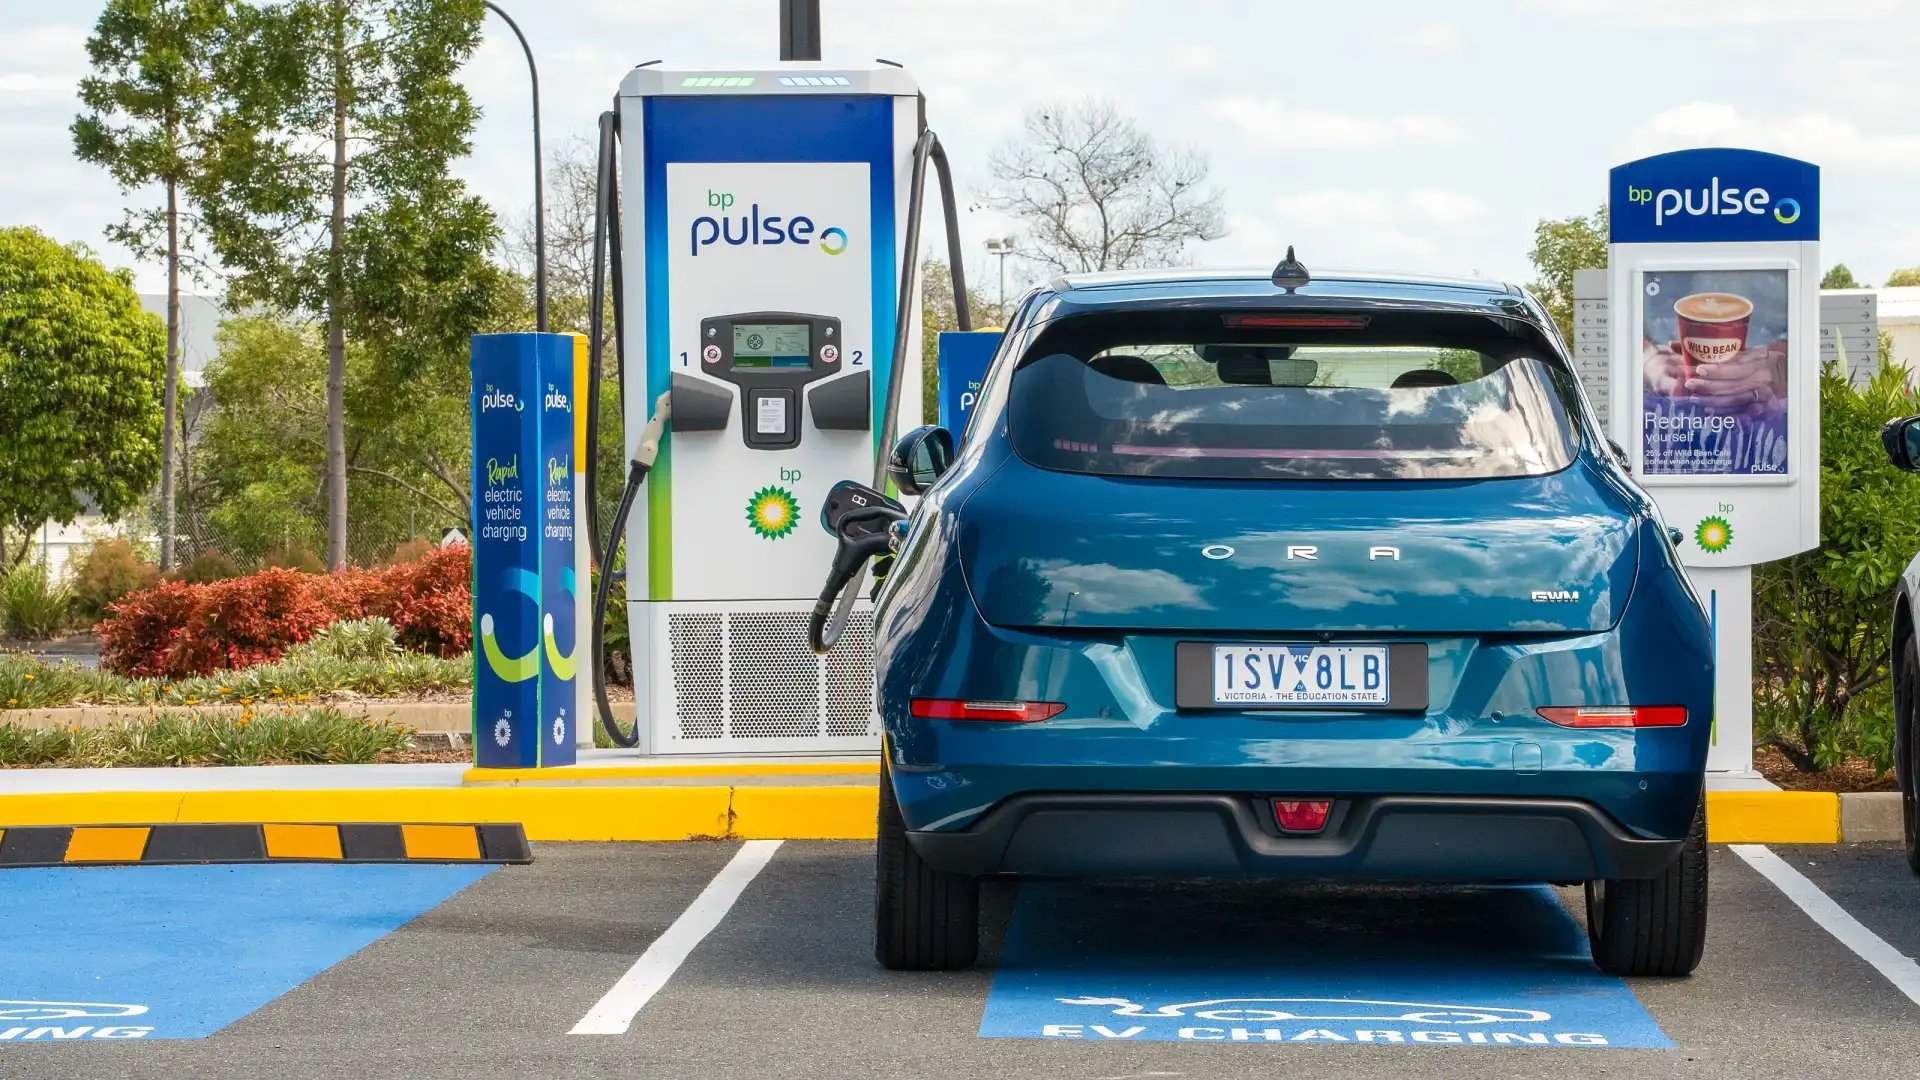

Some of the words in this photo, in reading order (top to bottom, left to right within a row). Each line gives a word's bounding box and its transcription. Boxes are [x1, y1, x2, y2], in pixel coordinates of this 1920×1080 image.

[708, 189, 734, 211] bp
[1629, 185, 1653, 206] bp
[1656, 176, 1770, 226] pulse
[691, 203, 815, 257] pulse
[1688, 341, 1710, 354] WILD
[1712, 342, 1737, 354] BEAN
[680, 352, 688, 366] 1
[852, 350, 863, 365] 2
[485, 383, 494, 393] bp
[548, 382, 555, 392] bp
[968, 380, 981, 390] bp
[482, 388, 514, 413] pulse
[545, 388, 567, 412] pulse
[1645, 412, 1735, 432] Recharge
[1646, 431, 1694, 444] yourself
[1663, 449, 1673, 457] off
[1674, 449, 1692, 457] Wild
[1693, 449, 1712, 457] Bean
[486, 453, 518, 486] Rapid
[548, 453, 568, 486] Rapid
[1692, 459, 1706, 467] you
[1707, 458, 1732, 467] charge
[1751, 462, 1777, 474] pulse
[780, 466, 802, 484] bp
[485, 486, 522, 502] electric
[547, 486, 570, 502] electric
[485, 504, 521, 520] vehicle
[547, 504, 570, 519] vehicle
[1719, 501, 1734, 514] bp
[482, 522, 526, 541] charging
[544, 522, 572, 541] charging
[1531, 591, 1579, 603] GWM
[1291, 654, 1309, 663] VIC
[1224, 653, 1285, 690] 1SV
[1316, 654, 1380, 690] 8LB
[1225, 692, 1267, 701] VICTORIA
[1276, 693, 1294, 701] THE
[1296, 693, 1347, 701] EDUCATION
[1351, 693, 1378, 701] STATE
[504, 708, 512, 718] bp
[1043, 1025, 1147, 1038] EV
[1178, 1027, 1609, 1046] CHARGING
